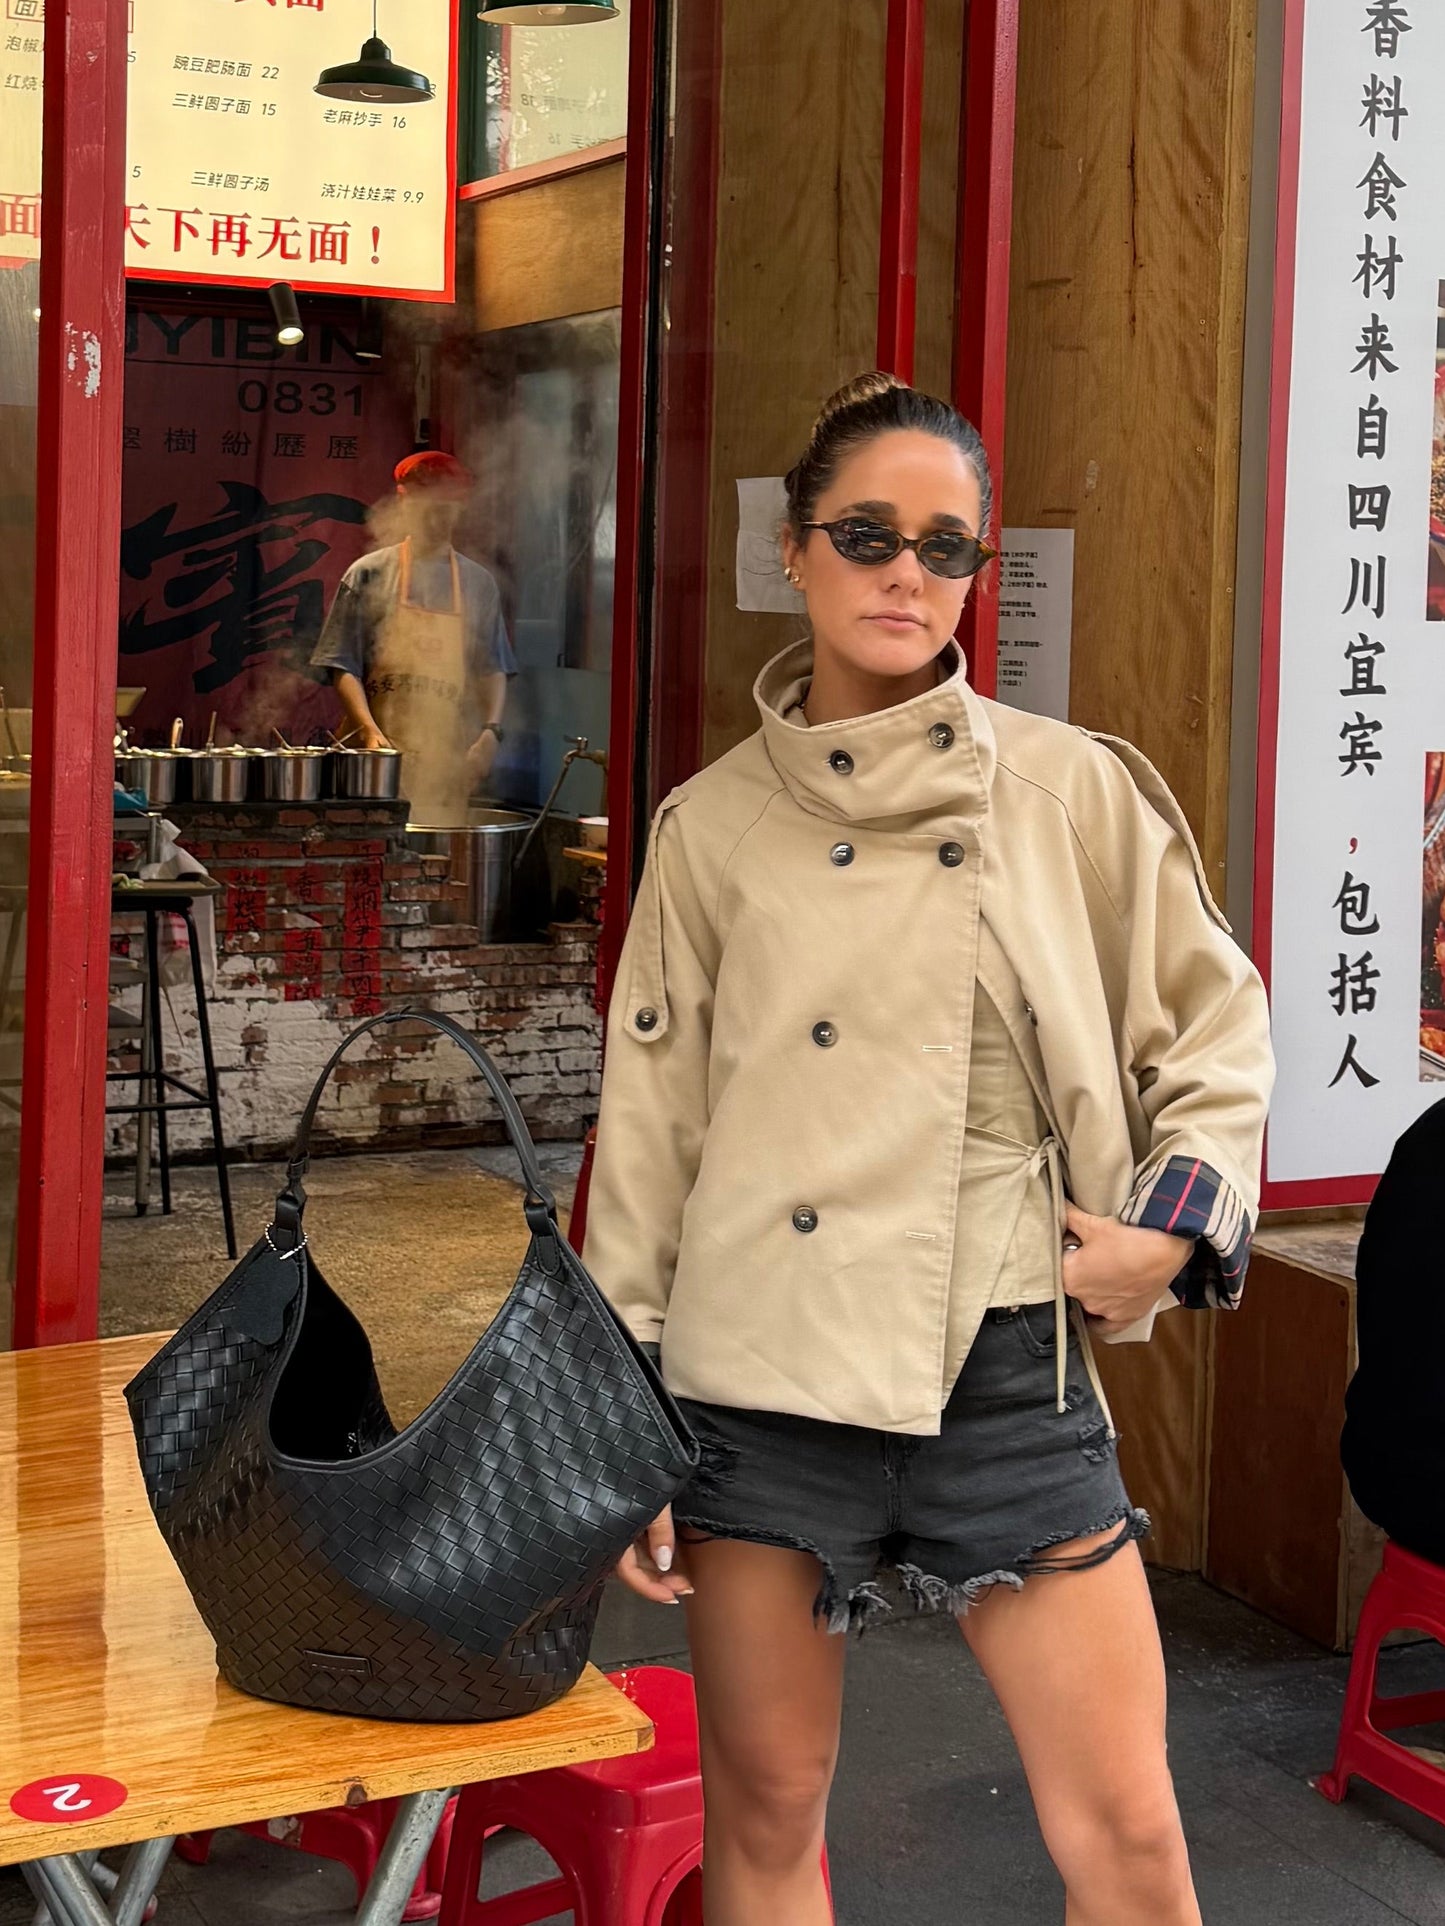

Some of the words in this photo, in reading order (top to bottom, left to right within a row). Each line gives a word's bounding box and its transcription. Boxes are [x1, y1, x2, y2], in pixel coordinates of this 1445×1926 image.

[5, 36, 44, 52] 泡椒
[173, 55, 253, 78] 豌豆肥肠面
[261, 66, 280, 80] 22
[4, 73, 44, 91] 红烧
[172, 93, 252, 115] 三鲜圆子面
[262, 103, 277, 117] 15
[323, 109, 383, 127] 老麻抄手
[392, 116, 407, 129] 16
[191, 171, 270, 192] 三鲜圆子汤
[321, 183, 397, 202] 浇汁娃娃菜
[403, 191, 425, 204] 9.9
[238, 379, 362, 416] 0831
[1327, 0, 1413, 1088] 香料食材来自四川宜宾，包括人
[42, 1782, 93, 1812] 2
